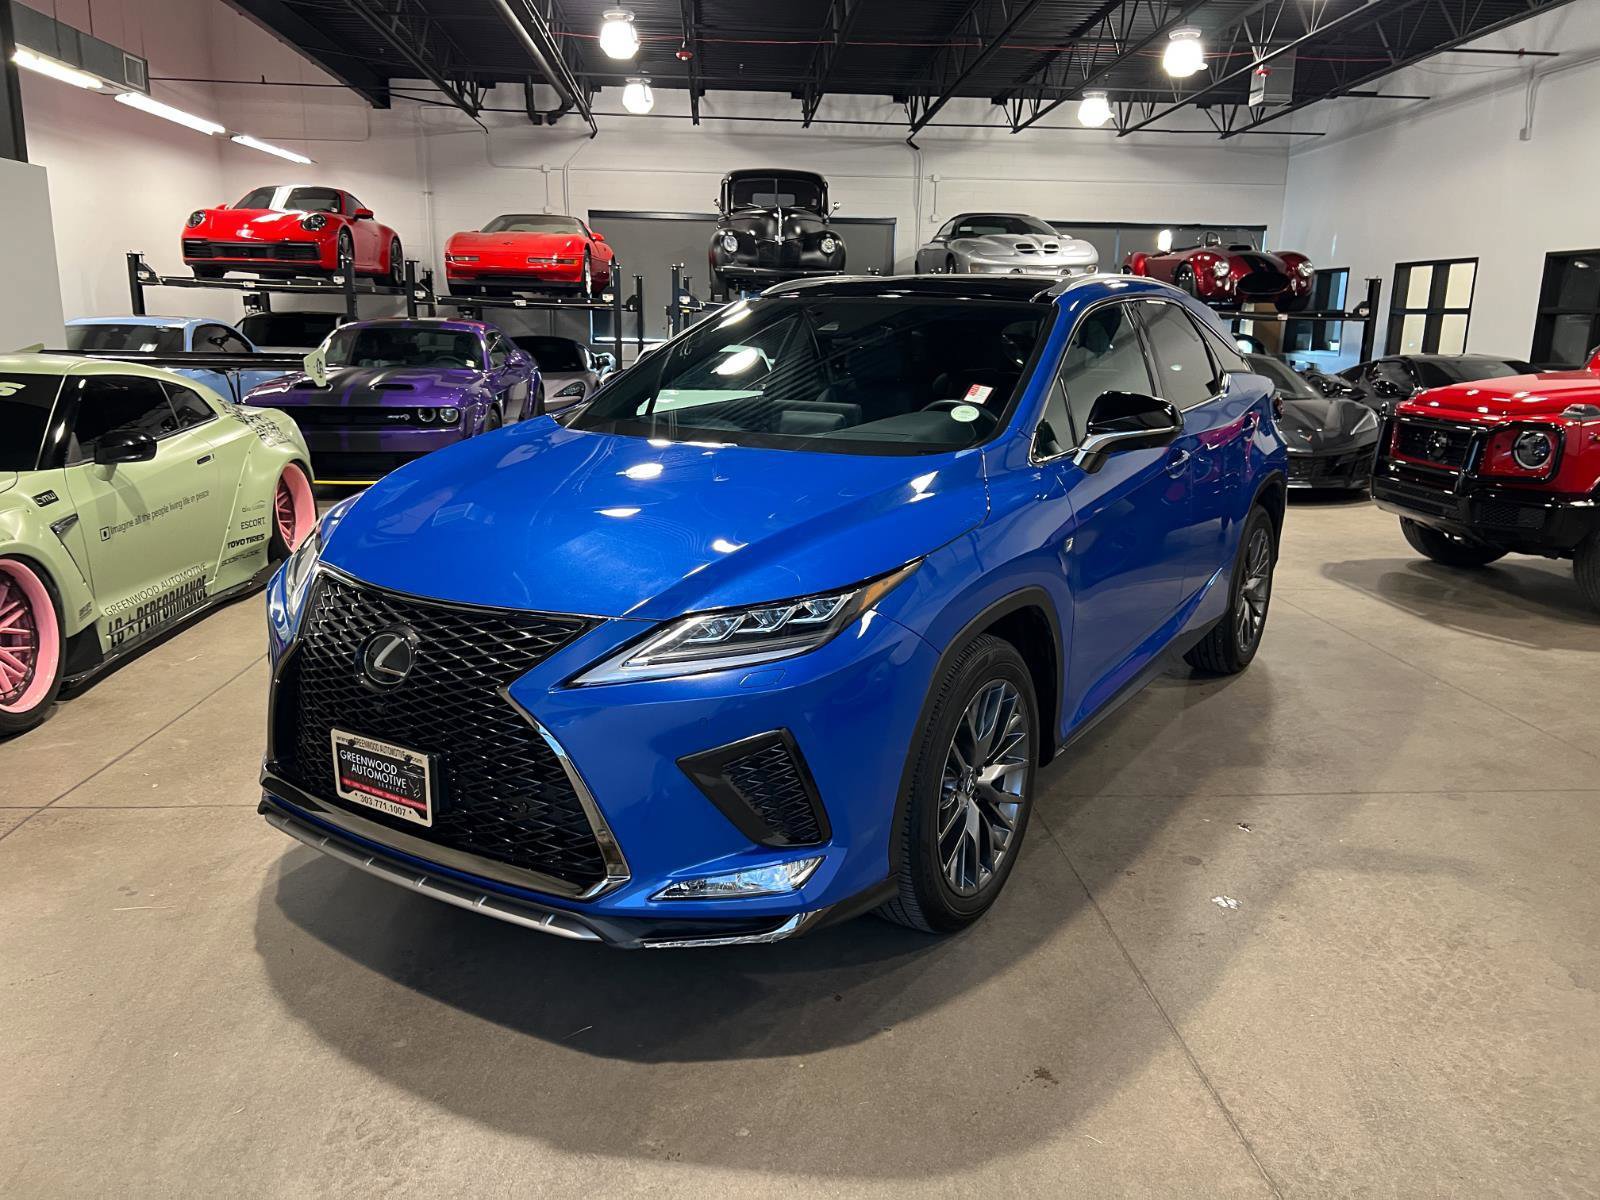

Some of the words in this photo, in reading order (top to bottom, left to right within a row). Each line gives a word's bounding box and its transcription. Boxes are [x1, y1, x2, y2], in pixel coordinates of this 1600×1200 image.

[110, 520, 134, 534] Imagine
[134, 515, 142, 526] all
[141, 512, 151, 523] the
[151, 505, 169, 520] people
[196, 489, 210, 502] peace
[240, 516, 266, 530] ESCORT
[227, 538, 245, 549] TOYO
[245, 533, 266, 545] TIRES
[104, 584, 160, 617] GREENWOOD
[160, 561, 207, 591] AUTOMOTIVE
[136, 574, 208, 633] PERFORMANCE
[339, 749, 398, 775] GREENWOOD
[351, 763, 407, 789] AUTOMOTIVE
[377, 781, 408, 795] SERVICES
[359, 794, 407, 816] 303.771.1007
